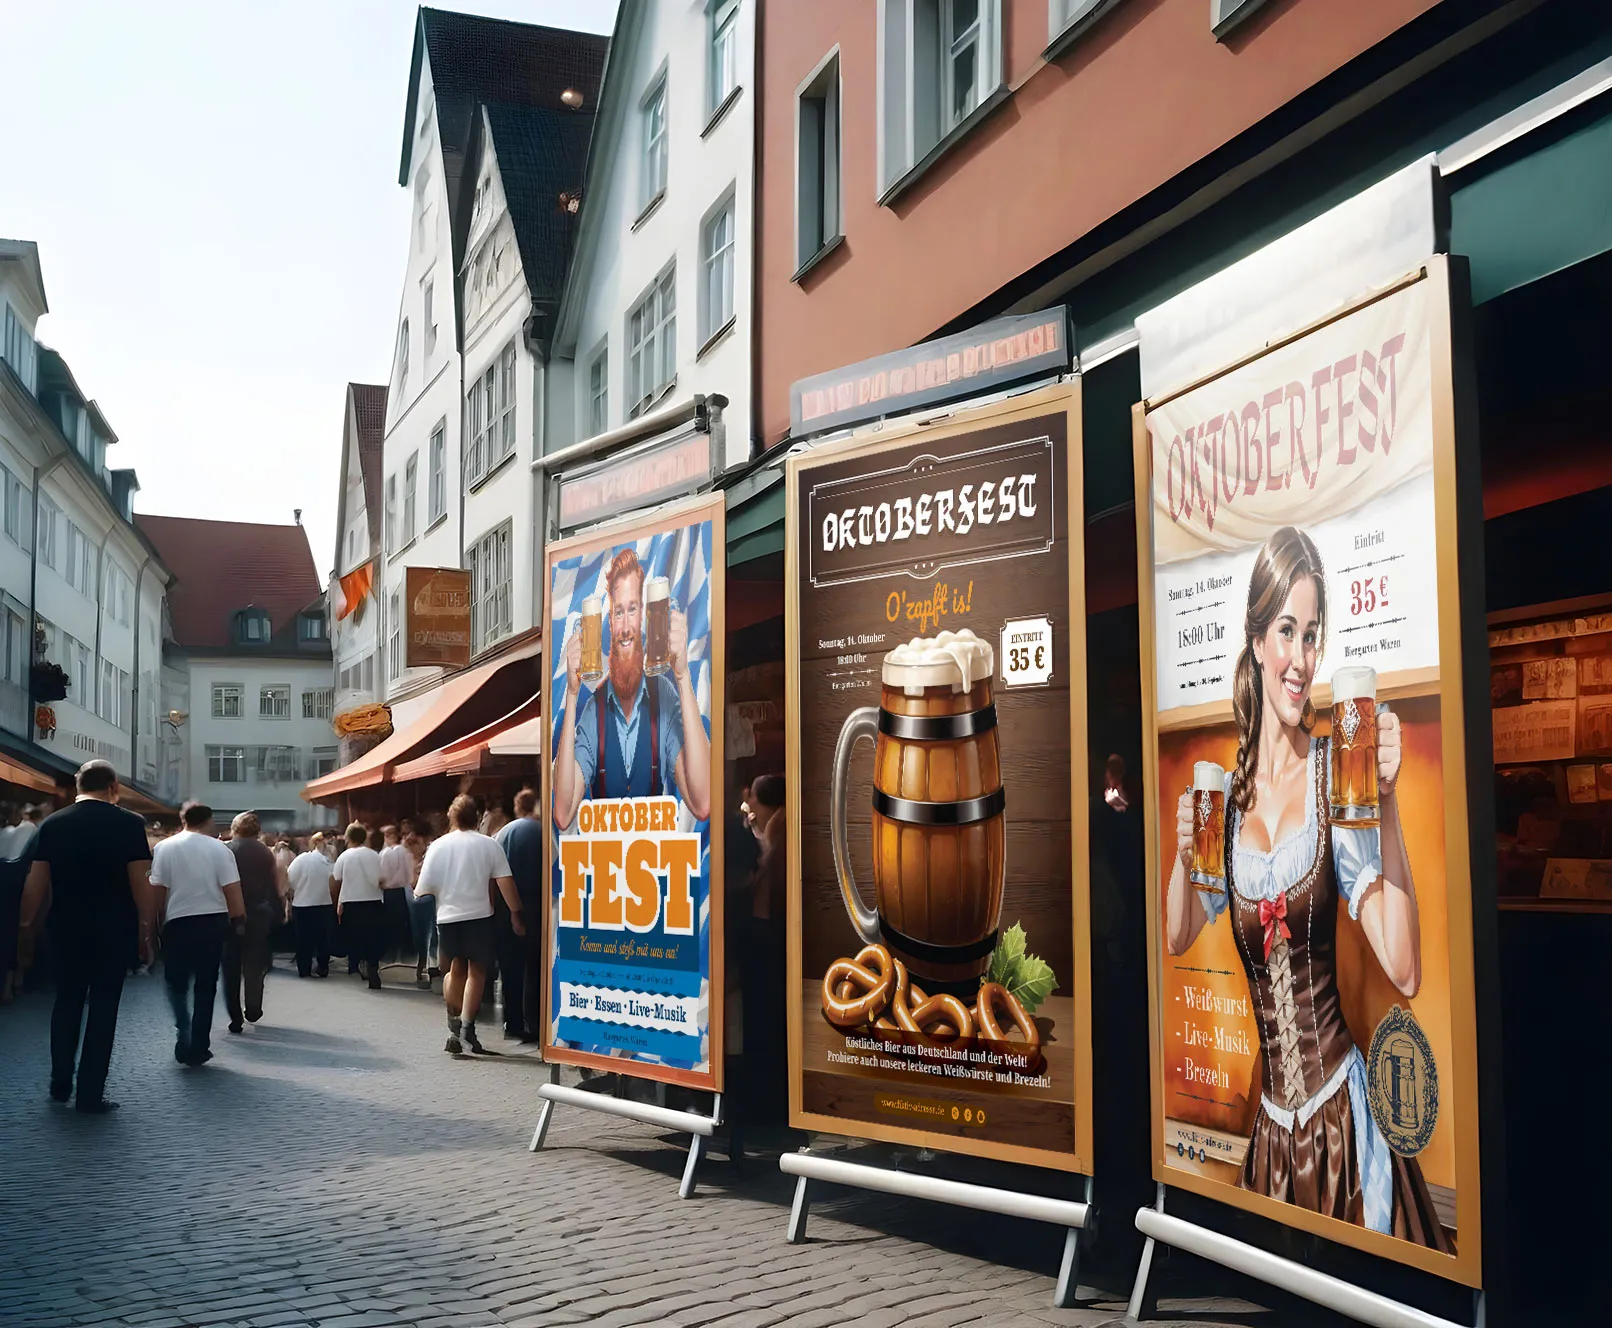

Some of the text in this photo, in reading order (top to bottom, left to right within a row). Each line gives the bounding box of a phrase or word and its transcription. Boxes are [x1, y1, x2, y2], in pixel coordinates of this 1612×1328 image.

[1168, 333, 1406, 532] OKTOBERFEST
[822, 473, 1037, 551] OKTOBERFEST
[1354, 530, 1385, 550] Eintritt
[886, 580, 974, 634] O'zapft is!
[1351, 575, 1389, 616] 35 €
[857, 633, 886, 645] Oktober
[1010, 631, 1044, 644] EINTRITT
[1178, 622, 1225, 649] 18:00 Uhr
[854, 653, 867, 663] Uhr
[1009, 645, 1045, 672] 35 €
[579, 801, 676, 833] OKTOBER
[561, 839, 698, 929] FEST
[580, 935, 602, 953] Komm
[603, 939, 618, 954] und
[650, 948, 664, 959] uns
[569, 992, 687, 1023] Bier Essen Live-Musik
[1183, 985, 1249, 1017] Weißwurst
[845, 1036, 1028, 1068] Köstliches Bier aus Deutschland und der Welt!
[1183, 1021, 1250, 1056] Live-Musik
[827, 1050, 1051, 1089] Probiere auch unsere leckeren Weißwürste und Brezeln!
[1184, 1056, 1230, 1089] Brezeln
